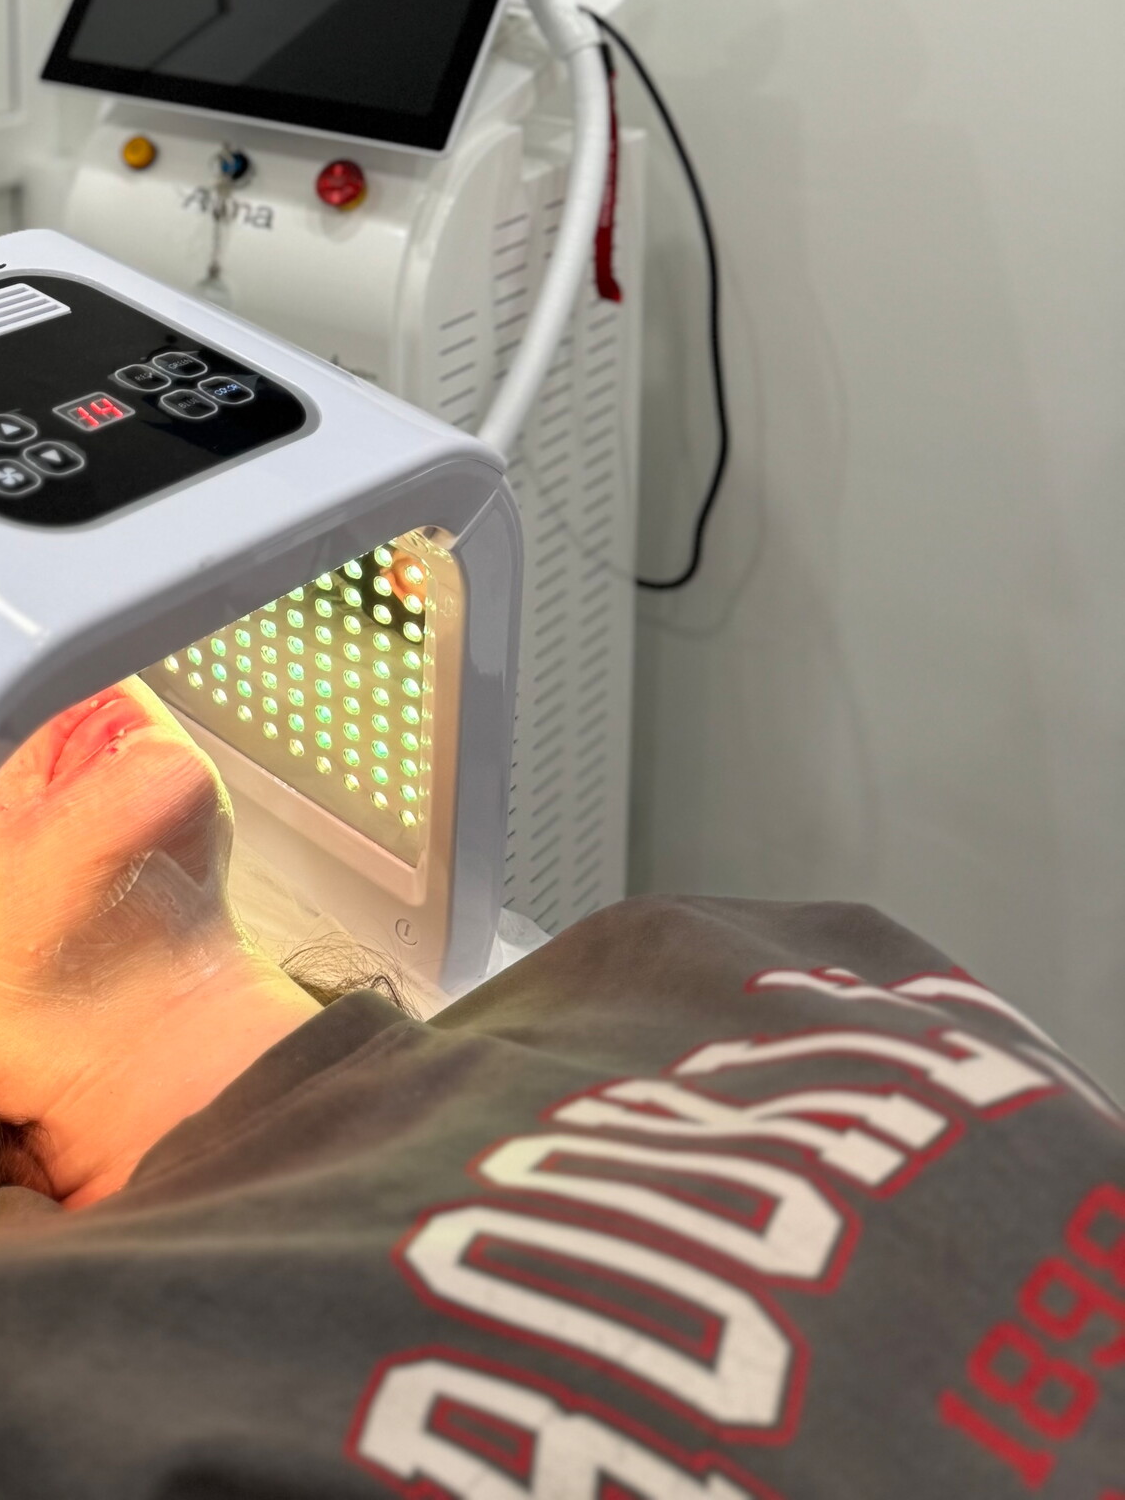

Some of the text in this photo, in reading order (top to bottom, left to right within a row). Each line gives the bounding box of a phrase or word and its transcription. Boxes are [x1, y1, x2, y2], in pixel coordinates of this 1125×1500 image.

[178, 185, 274, 231] Ama
[214, 383, 241, 396] COLOR
[77, 397, 124, 428] 14
